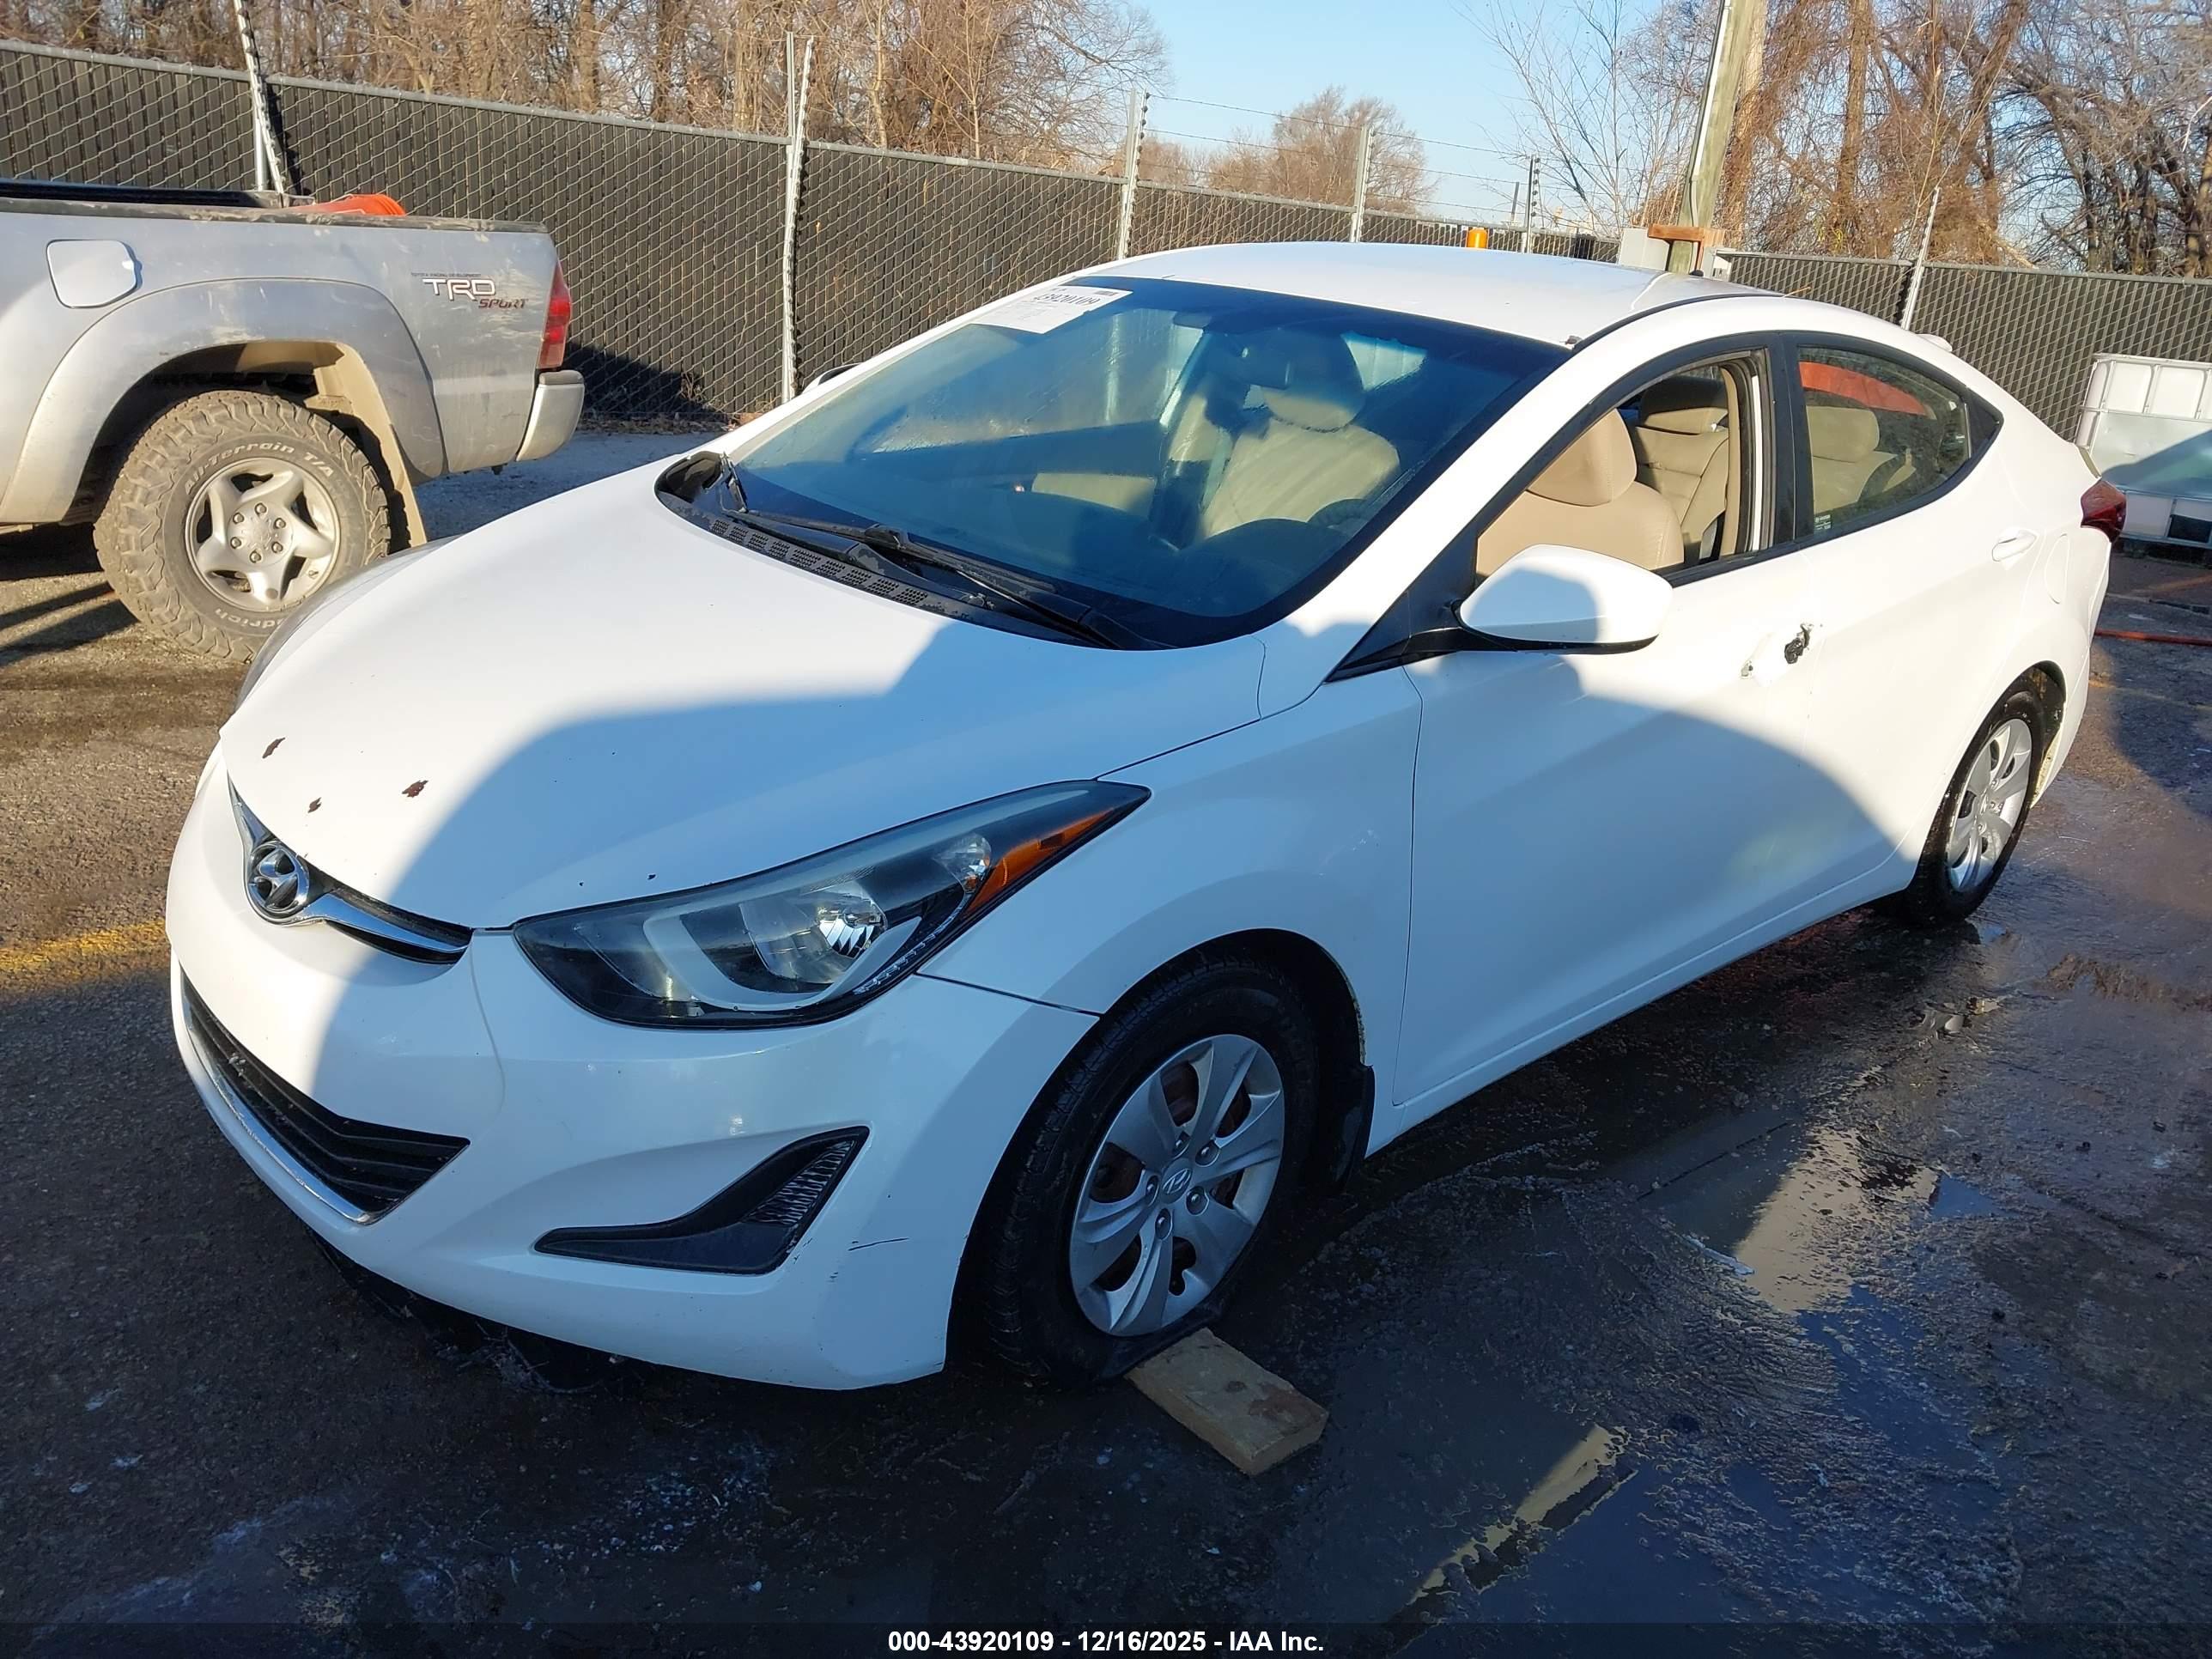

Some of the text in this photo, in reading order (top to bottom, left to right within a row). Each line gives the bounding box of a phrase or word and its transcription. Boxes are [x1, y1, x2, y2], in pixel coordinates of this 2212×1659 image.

[421, 277, 496, 302] TRD
[478, 297, 530, 309] SPORT
[304, 452, 334, 477] T/A
[214, 608, 283, 629] drich
